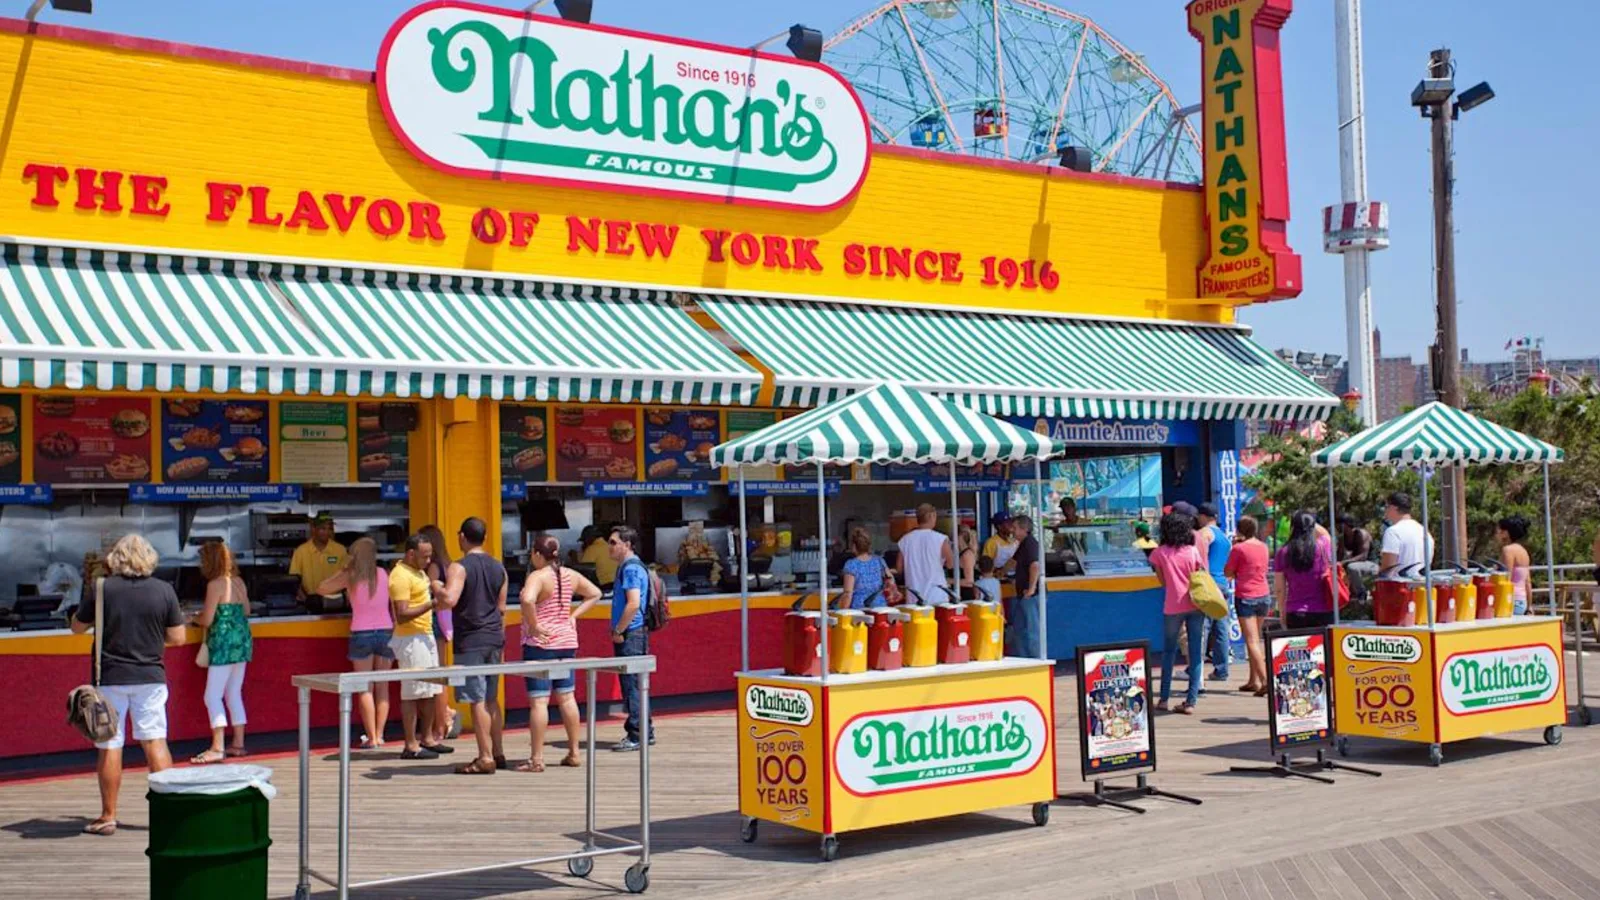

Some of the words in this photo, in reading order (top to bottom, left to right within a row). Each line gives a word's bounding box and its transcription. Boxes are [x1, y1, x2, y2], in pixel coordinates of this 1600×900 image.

[676, 61, 720, 82] Since
[724, 69, 756, 88] 1916
[428, 20, 825, 161] Nathan's
[1212, 9, 1250, 257] NATHANS
[585, 152, 717, 182] FAMOUS
[23, 163, 170, 217] THE
[206, 182, 445, 241] FLAVOR
[471, 207, 539, 248] OF
[566, 215, 680, 260] NEW
[701, 229, 823, 272] YORK
[843, 243, 964, 283] SINCE
[980, 256, 1060, 291] 1916
[1211, 257, 1260, 275] FAMOUS
[1203, 266, 1270, 294] FRANKFURTERS
[0, 487, 25, 495] STERS
[156, 485, 174, 494] NOW
[175, 485, 214, 494] AVAILABLE
[215, 485, 225, 494] AT
[225, 485, 239, 494] ALL
[240, 485, 278, 494] REGISTERS
[1221, 450, 1237, 540] Aunti
[1285, 649, 1311, 661] WIN
[1347, 635, 1414, 655] Nathan's
[1101, 664, 1129, 678] WIN
[1355, 676, 1377, 686] FOR
[1381, 674, 1411, 684] OVER
[1449, 653, 1548, 694] Nathan's
[1093, 680, 1110, 690] VIP
[750, 686, 808, 715] Nathan's
[1355, 684, 1414, 710] 100
[957, 713, 977, 723] Since
[1355, 710, 1417, 724] YEARS
[757, 742, 775, 753] FOR
[778, 740, 804, 752] OVER
[852, 710, 1026, 768] Nathan's
[756, 754, 807, 785] 100
[918, 764, 976, 779] FAMOUS
[756, 788, 808, 805] YEARS
